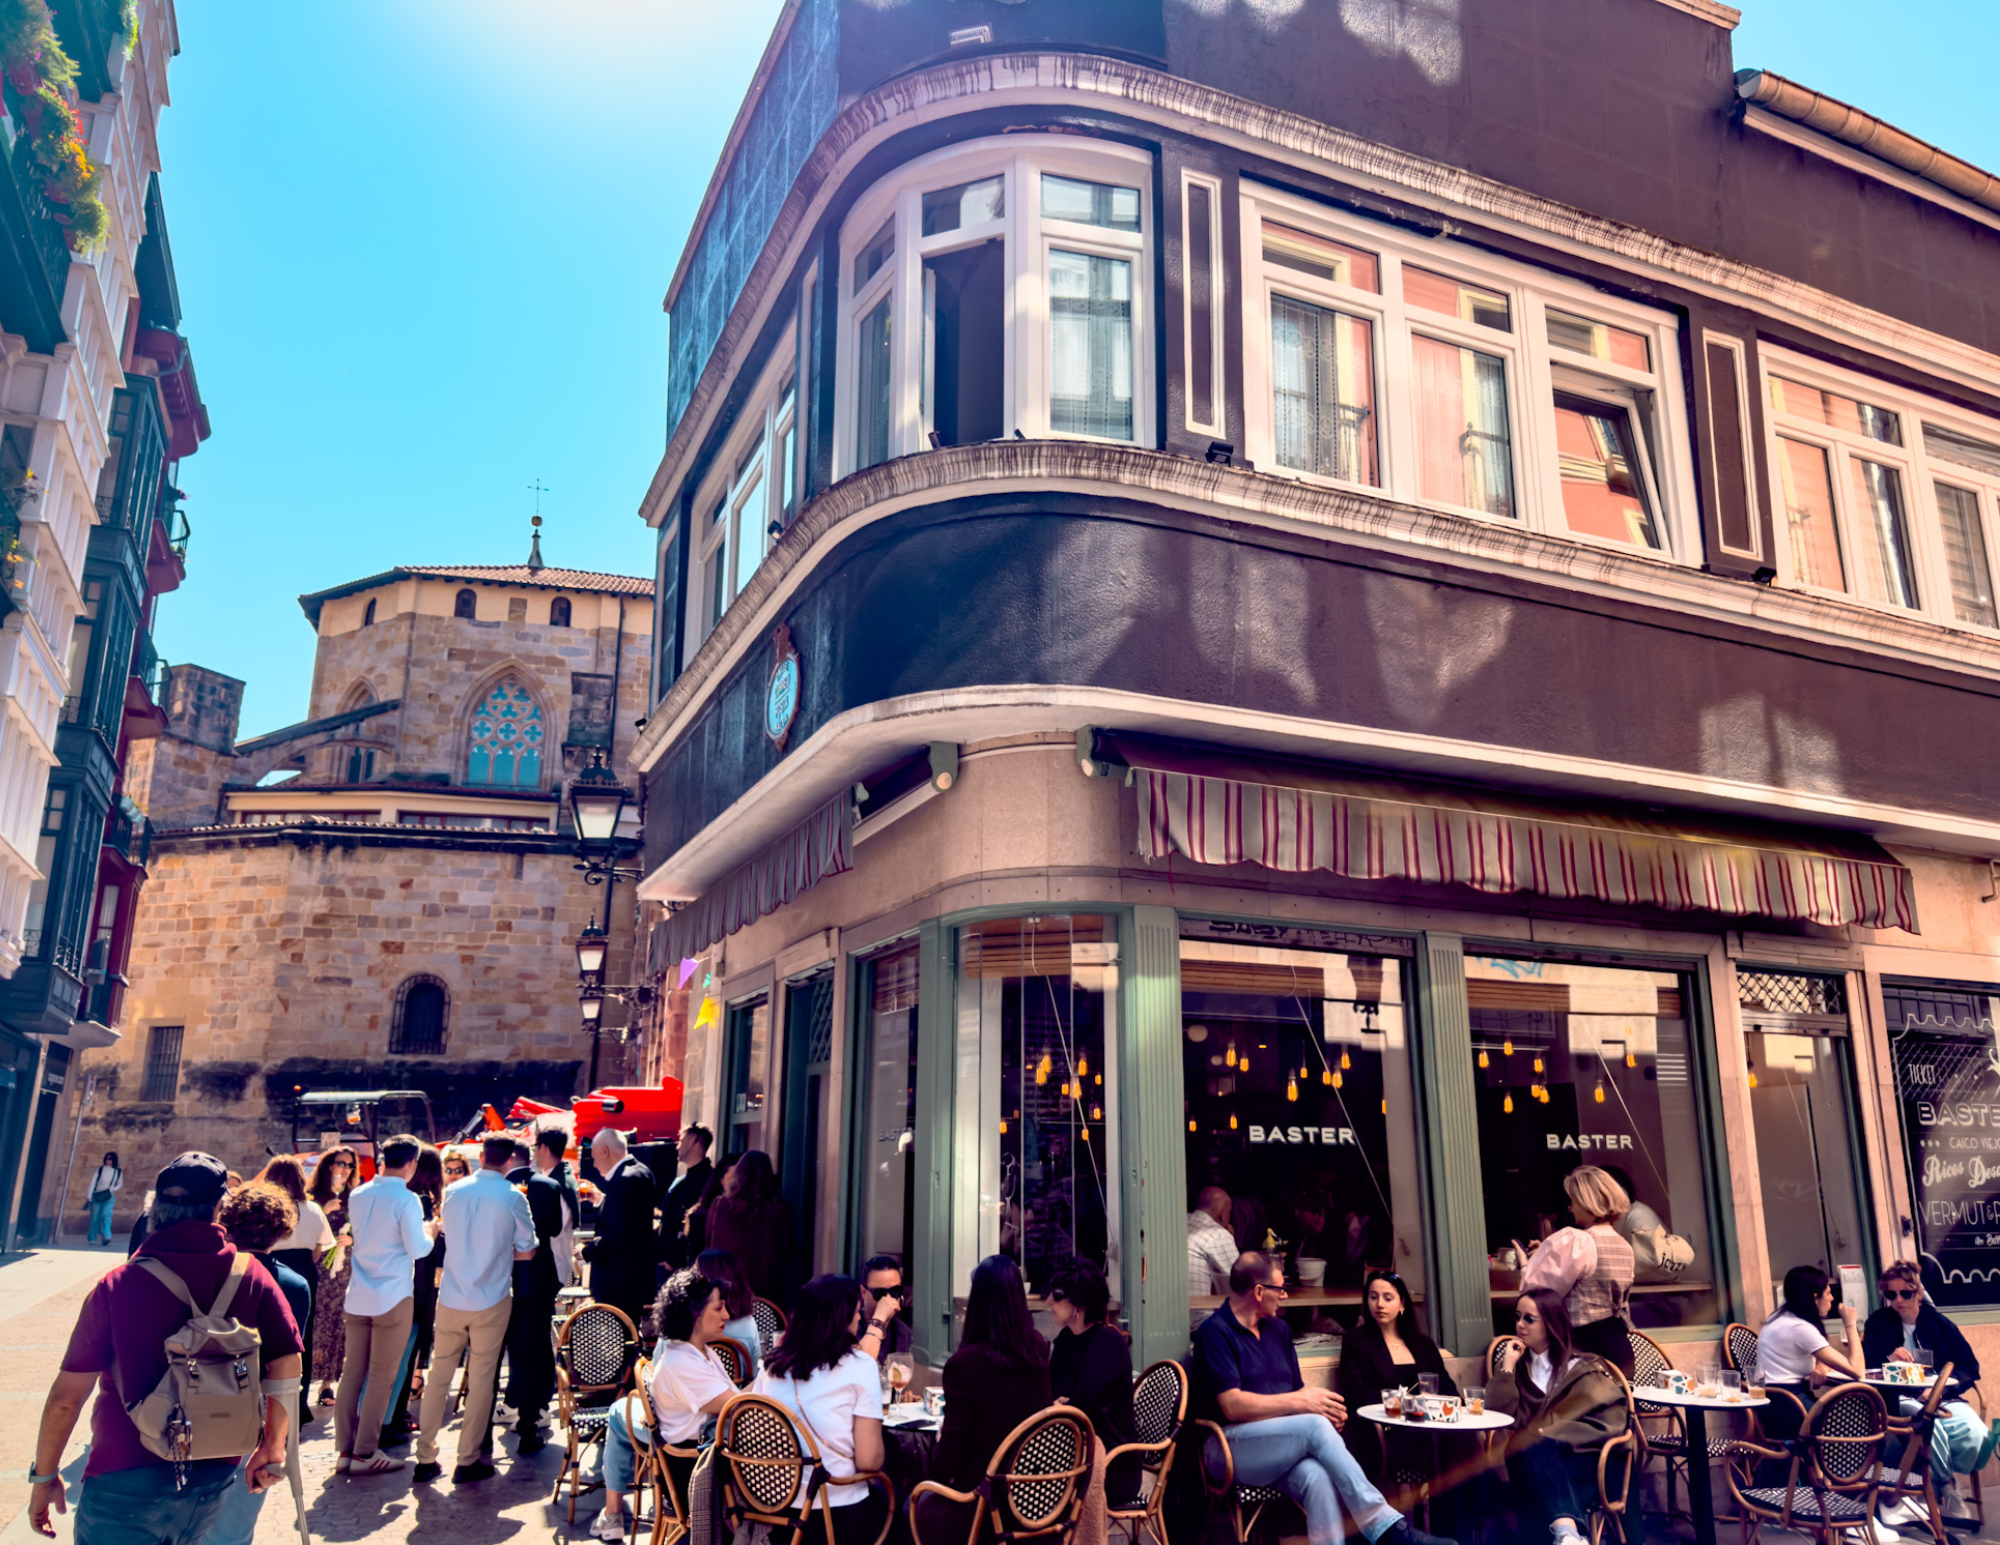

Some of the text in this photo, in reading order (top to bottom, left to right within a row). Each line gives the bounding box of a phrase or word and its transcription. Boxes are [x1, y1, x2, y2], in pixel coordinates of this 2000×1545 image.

[1248, 1125, 1356, 1144] BASTER
[1546, 1134, 1633, 1149] BASTER
[1922, 1154, 1964, 1187] Ricos
